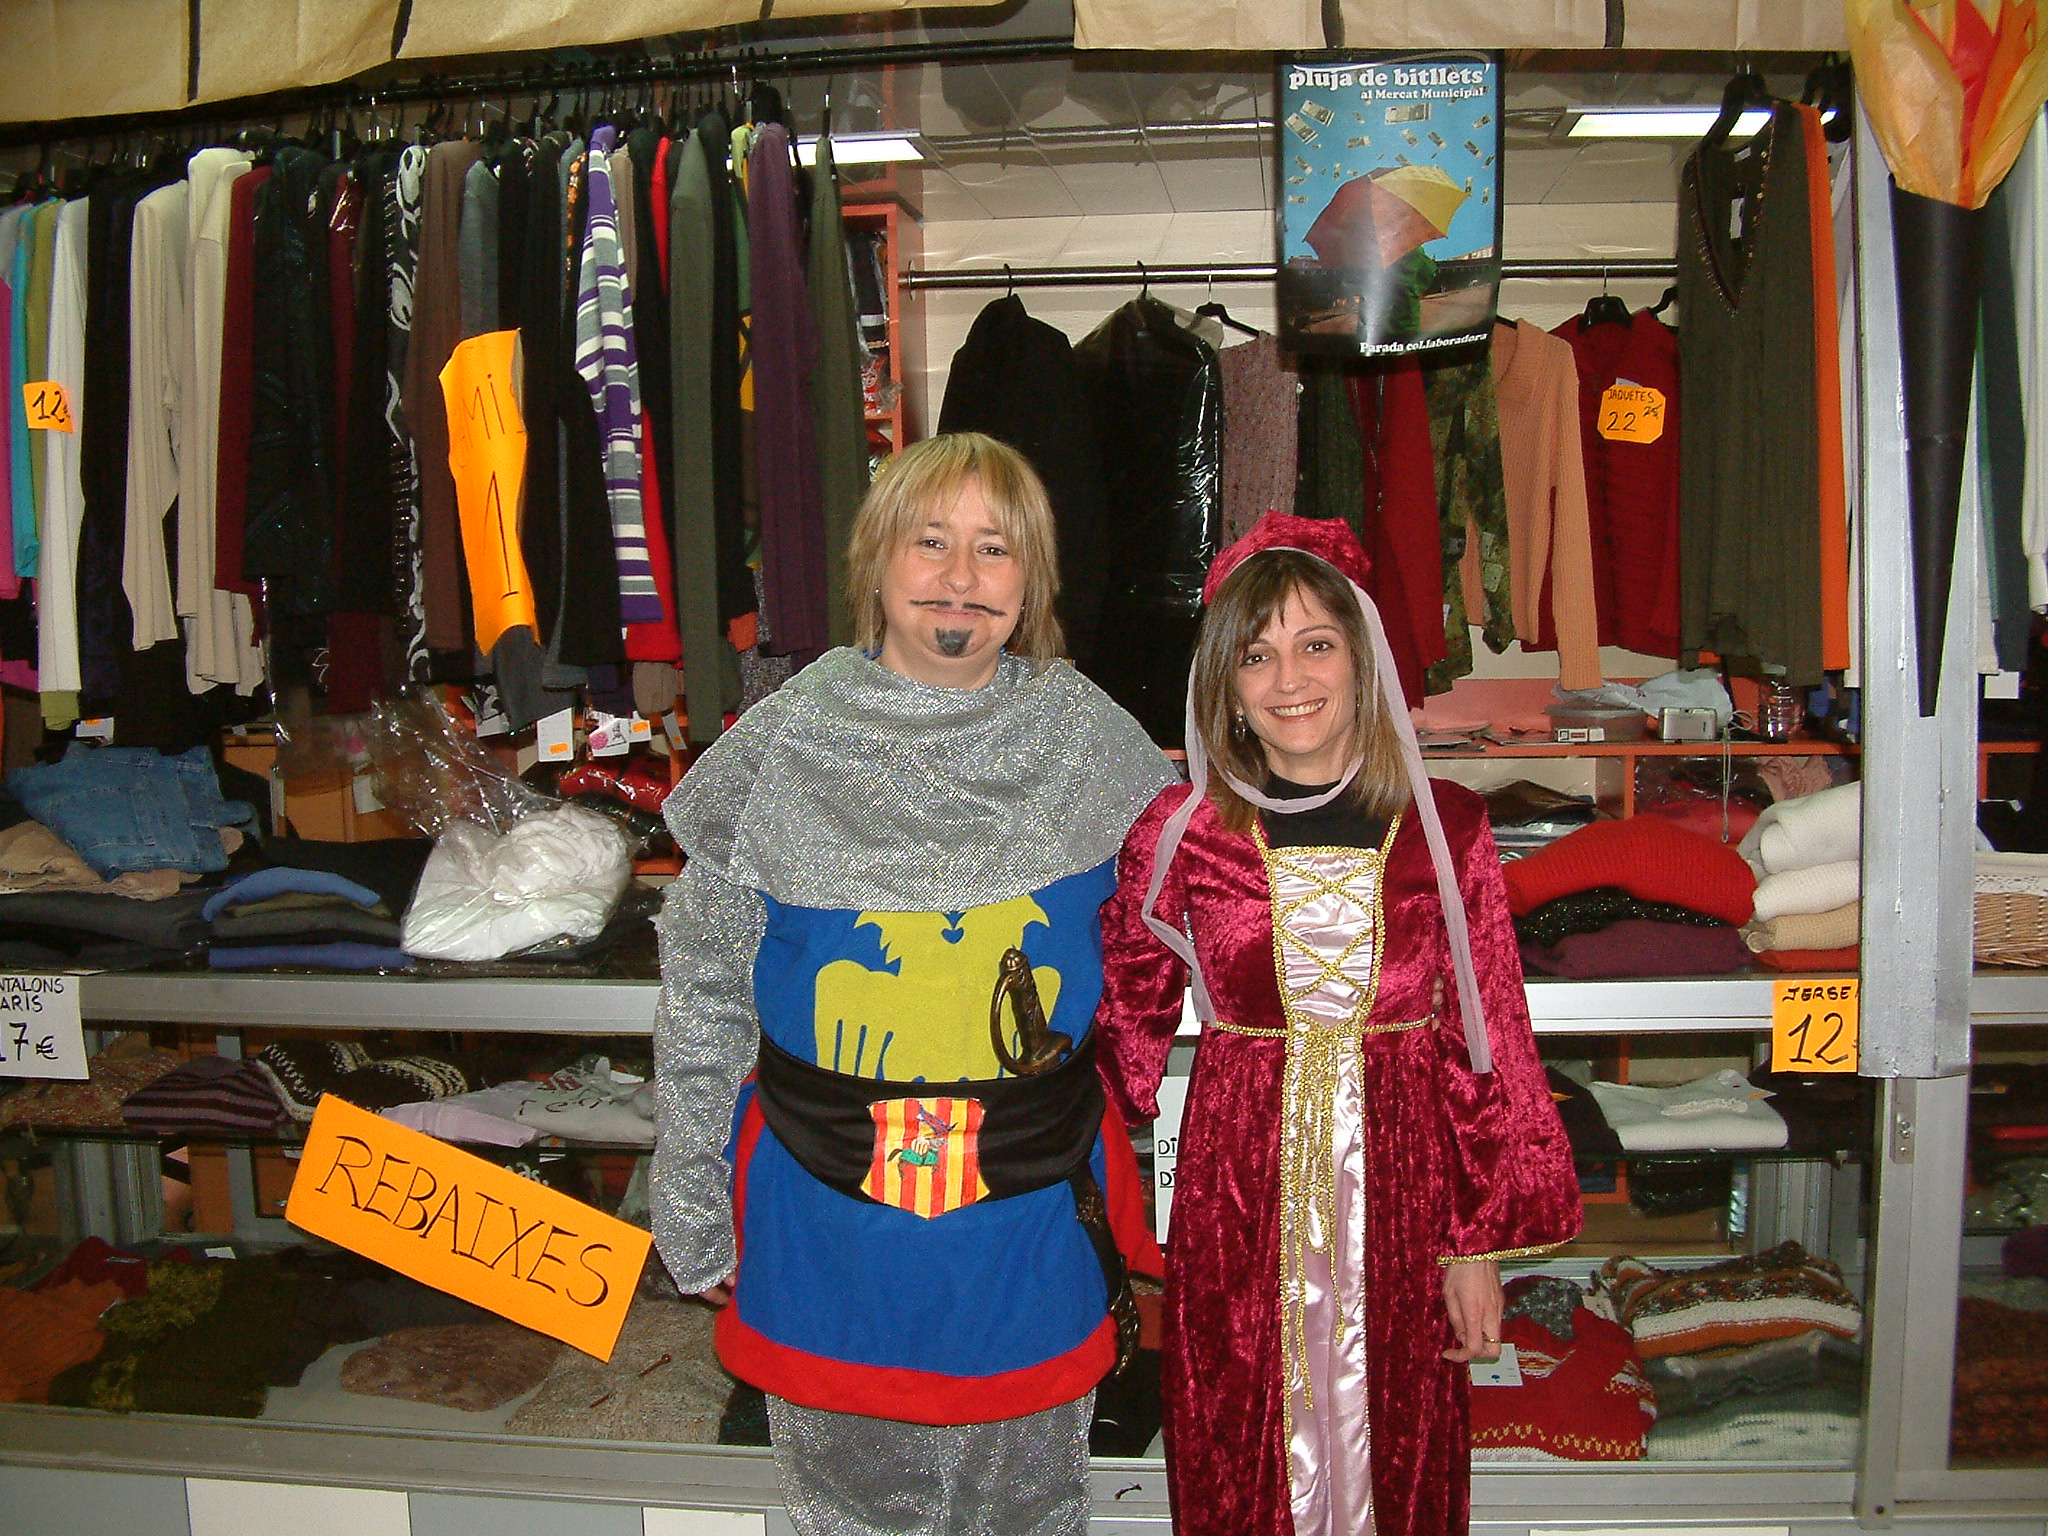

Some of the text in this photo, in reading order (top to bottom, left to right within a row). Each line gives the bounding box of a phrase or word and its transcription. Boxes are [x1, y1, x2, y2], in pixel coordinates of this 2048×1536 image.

[1289, 68, 1484, 89] pluja de bitllets
[1360, 86, 1484, 100] al Mercat Municipal
[1360, 341, 1404, 353] Parada
[1606, 410, 1636, 432] 22
[315, 1135, 614, 1308] REBAIXES
